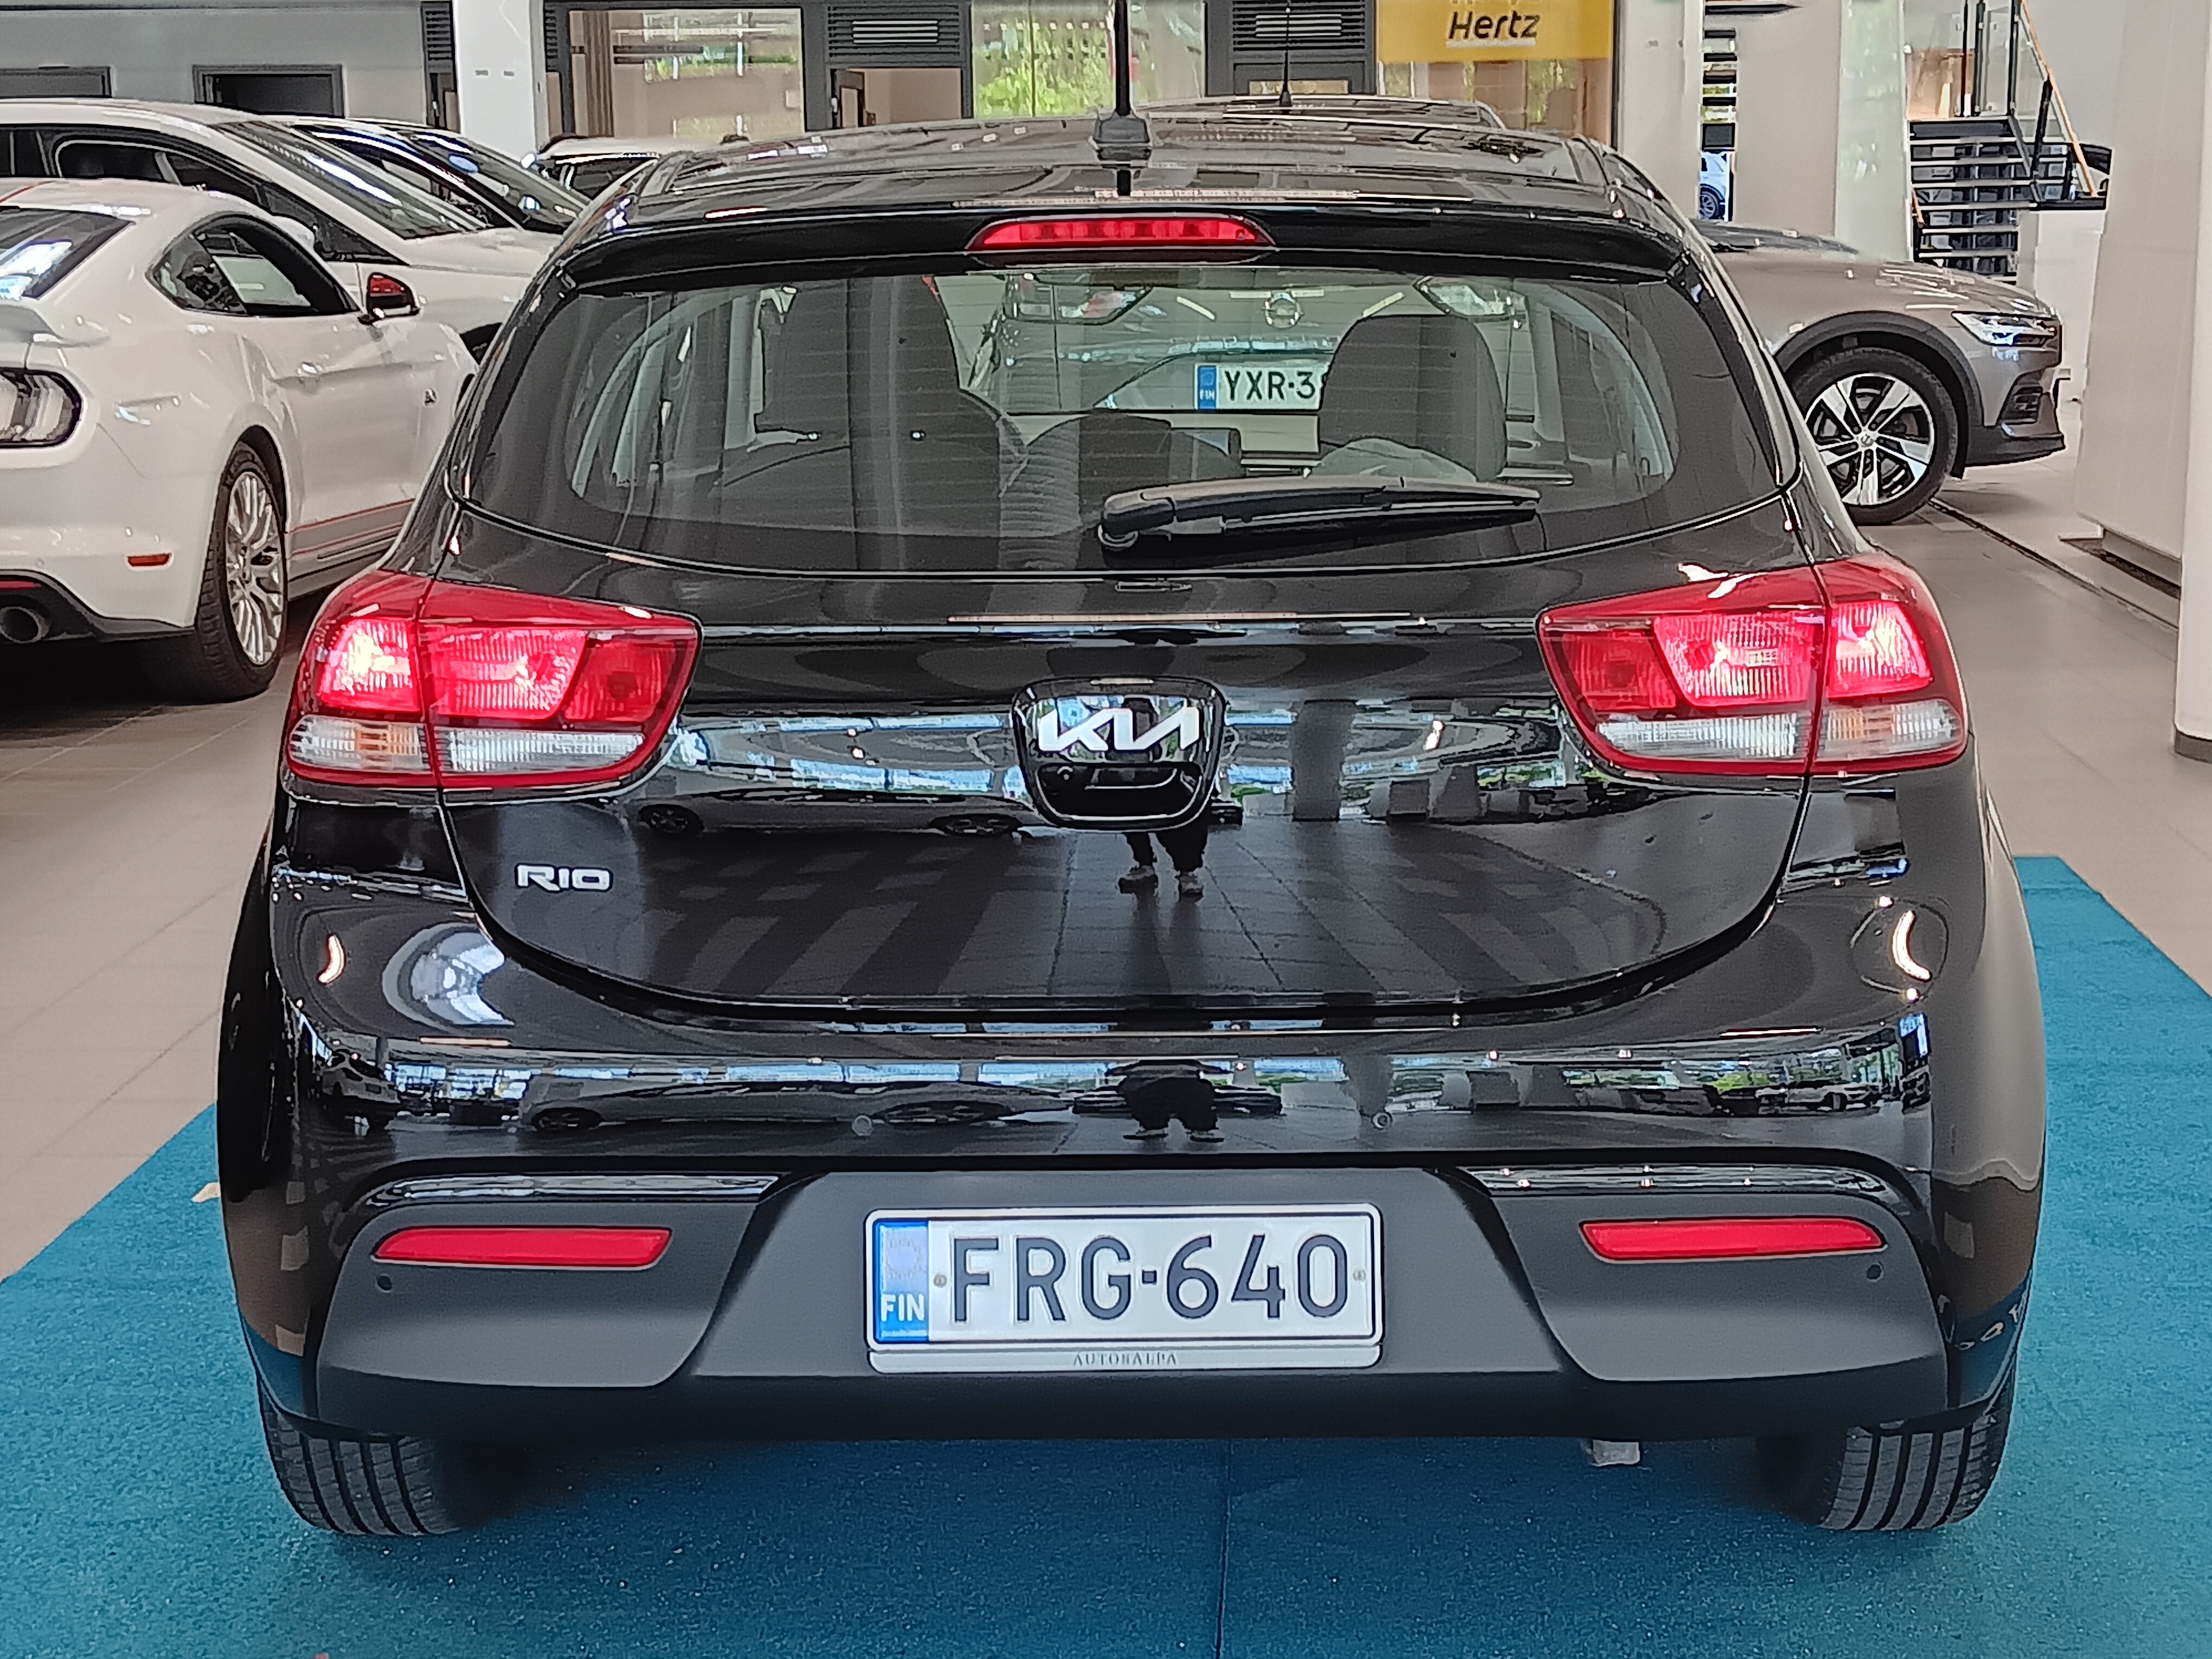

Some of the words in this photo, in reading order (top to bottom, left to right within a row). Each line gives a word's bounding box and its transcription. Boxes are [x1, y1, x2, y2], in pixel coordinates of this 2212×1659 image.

[1449, 10, 1540, 39] Hertz
[1224, 371, 1326, 400] YXR-3
[1039, 706, 1199, 751] KIA
[517, 865, 610, 891] RIO
[880, 1293, 925, 1322] FIN
[953, 1233, 1349, 1324] FRG-640
